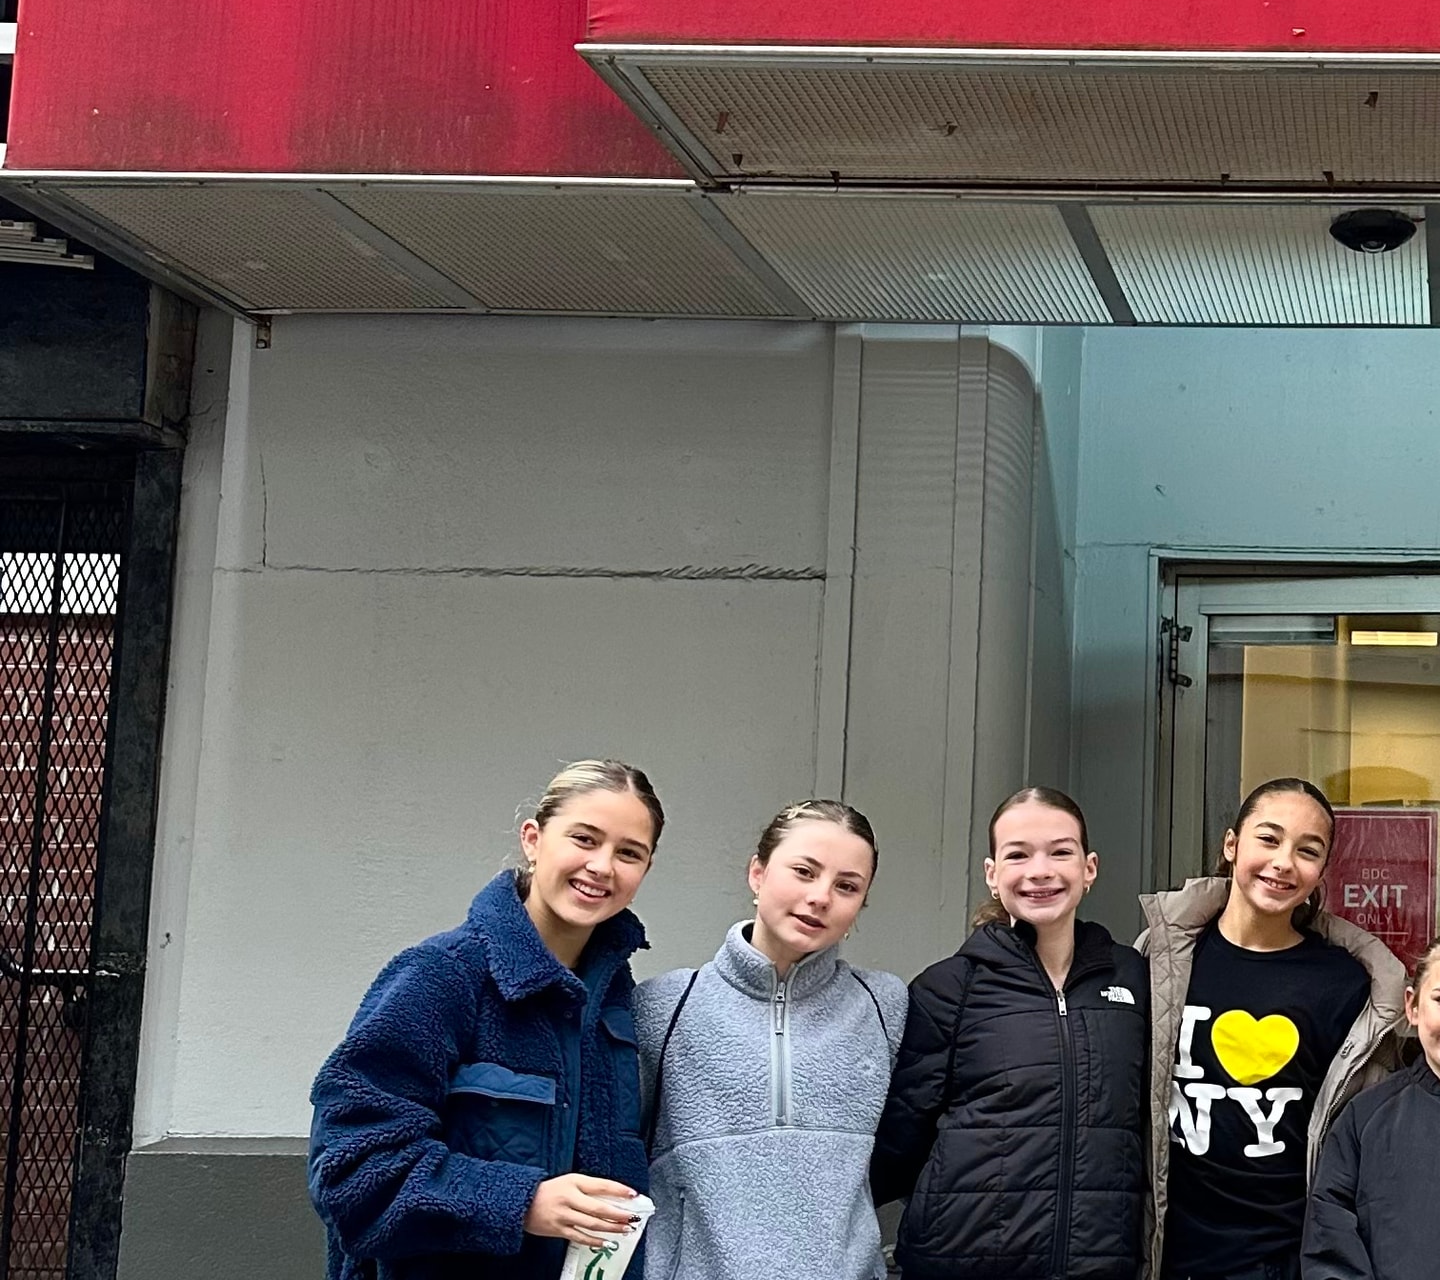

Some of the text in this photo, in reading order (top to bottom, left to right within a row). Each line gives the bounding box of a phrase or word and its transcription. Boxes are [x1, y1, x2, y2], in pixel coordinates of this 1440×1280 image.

[1361, 868, 1390, 880] BDC
[1344, 884, 1408, 908] EXIT
[1356, 913, 1393, 925] ONLY
[1173, 1005, 1212, 1079] I
[1168, 1080, 1303, 1158] NY
